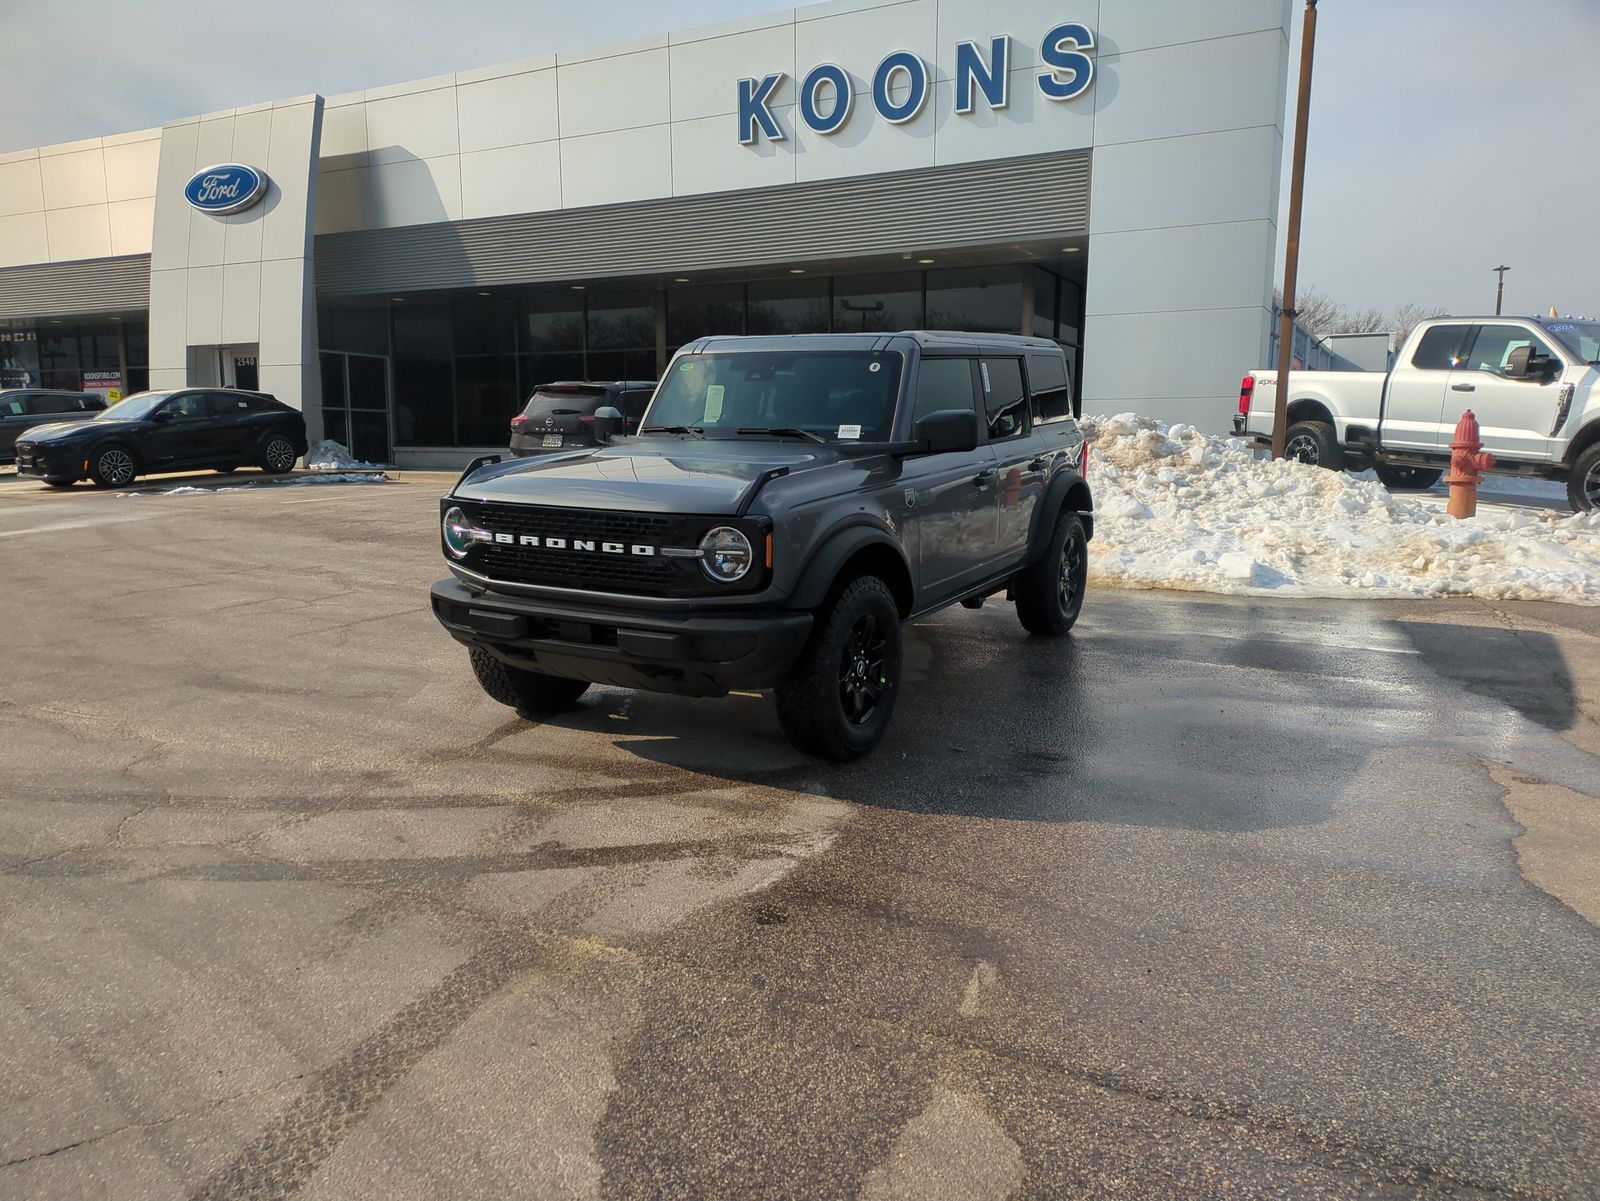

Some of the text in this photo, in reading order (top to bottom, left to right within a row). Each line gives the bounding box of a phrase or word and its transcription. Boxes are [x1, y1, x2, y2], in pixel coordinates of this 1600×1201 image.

[737, 22, 1095, 145] KOONS
[197, 173, 241, 202] Ford
[237, 358, 255, 367] 2540
[84, 372, 121, 380] KOONSFORD.COM
[495, 532, 655, 557] BRONCO
